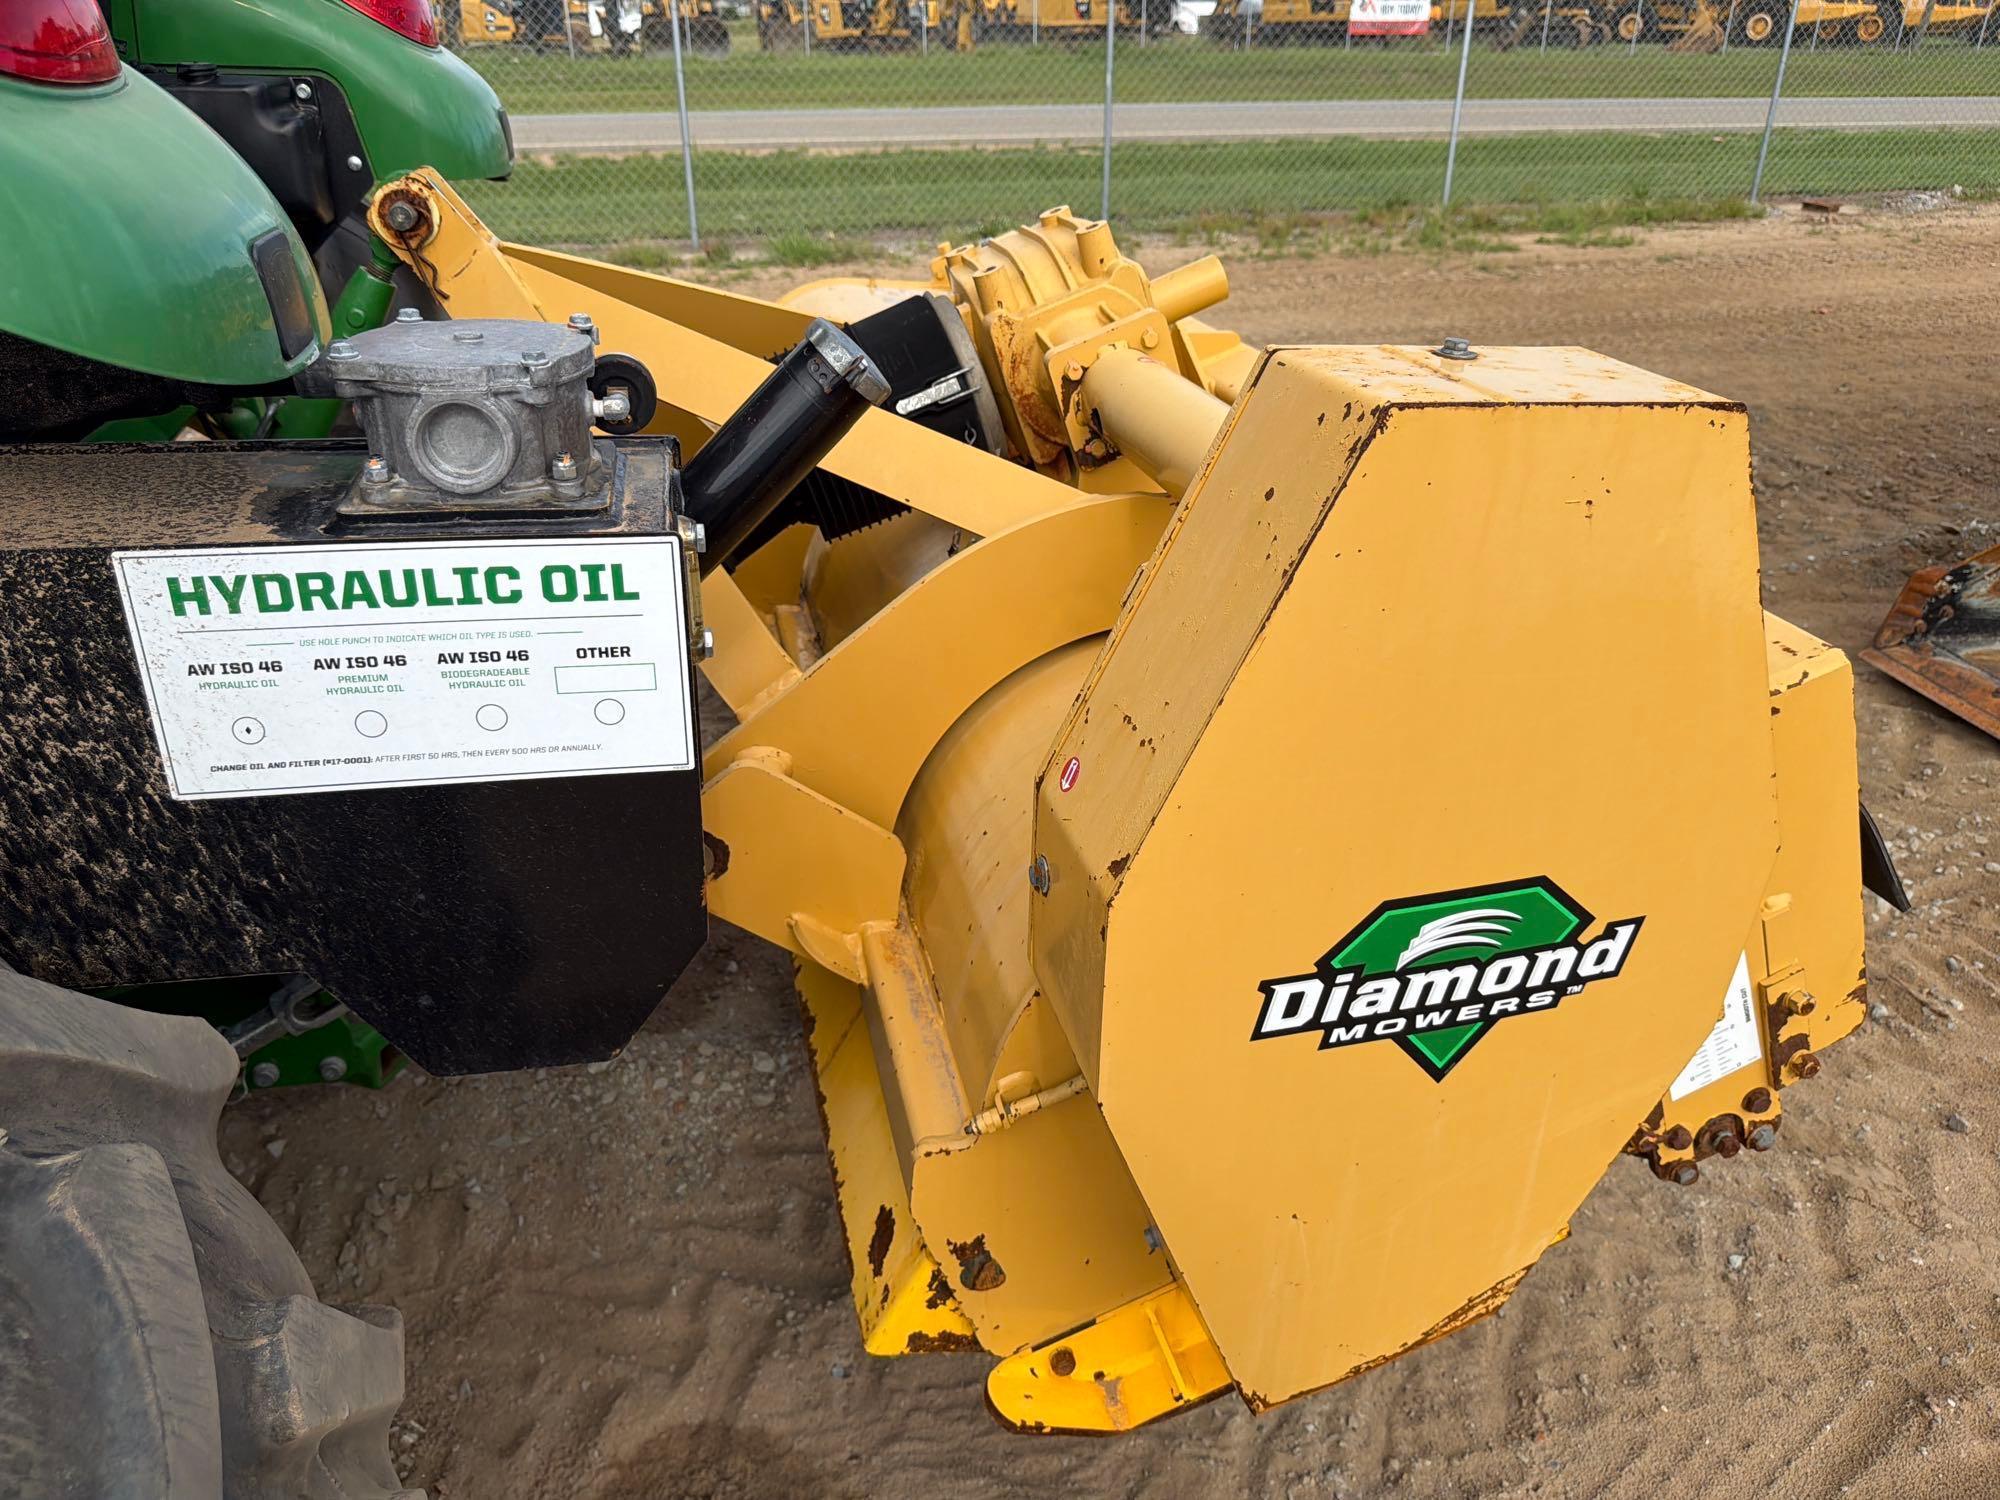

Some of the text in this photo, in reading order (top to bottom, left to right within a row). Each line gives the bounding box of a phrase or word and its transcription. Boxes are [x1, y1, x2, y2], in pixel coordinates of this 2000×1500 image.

[166, 564, 640, 617] HYDRAULIC OIL
[299, 630, 534, 647] USE HOLE PUNCH TO INDICATE WHICH OIL TYPE IS USED.
[437, 649, 530, 665] AW ISO 46
[576, 646, 631, 659] OTHER
[187, 660, 283, 676] AW ISO 46
[313, 654, 407, 671] AW ISO 46
[338, 673, 389, 683] PREMIUM
[441, 667, 531, 679] BIODEGRADEABLE
[199, 679, 280, 691] HYDRAULIC OIL
[326, 684, 405, 695] HYDRAULIC OIL
[449, 678, 526, 690] HYDRAULIC OIL
[210, 764, 248, 773] CHANGE
[250, 762, 266, 771] OIL
[267, 761, 287, 769] AND
[288, 759, 321, 768] FILTER
[375, 754, 400, 763] AFTER
[402, 752, 426, 761] FIRST
[428, 752, 440, 760] 50
[462, 749, 483, 758] THEN
[485, 748, 511, 757] EVERY
[511, 747, 529, 755] 500
[530, 746, 547, 754] HRS
[548, 745, 560, 753] OR
[561, 743, 604, 752] ANNUALLY.
[1260, 923, 1637, 1033] Diamond
[1328, 990, 1555, 1044] MOWERS
